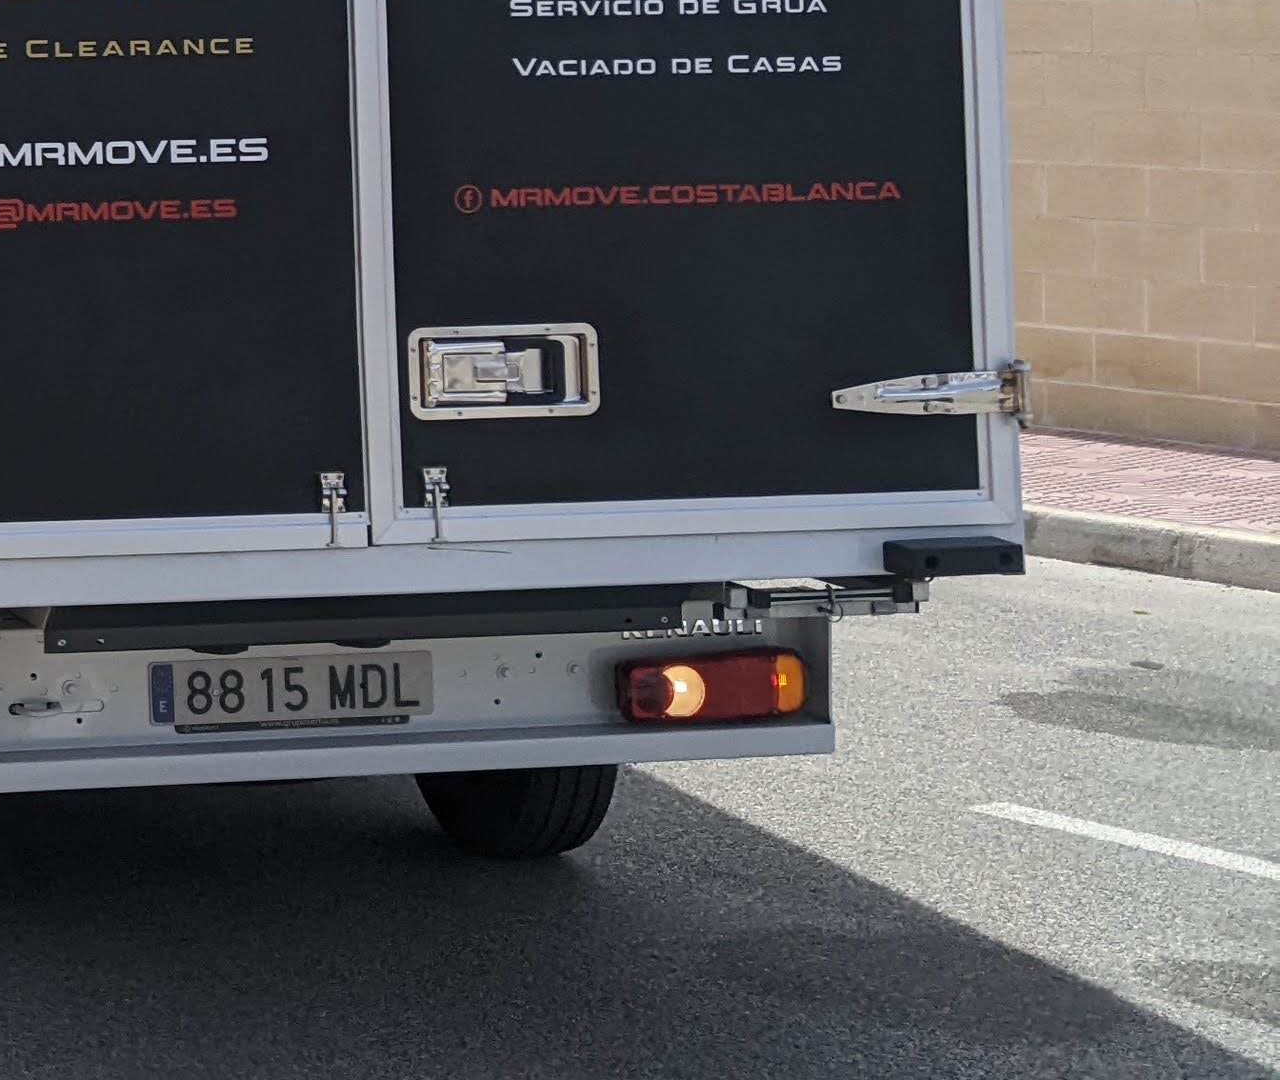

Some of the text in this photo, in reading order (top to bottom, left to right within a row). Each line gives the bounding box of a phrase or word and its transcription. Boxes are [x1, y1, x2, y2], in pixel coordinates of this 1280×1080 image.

[25, 37, 254, 58] CLEARANCE
[512, 54, 842, 76] VACIADO DE CASAS
[490, 181, 901, 208] MRMOVE.COSTABLANCA
[187, 667, 309, 715] 8815
[329, 662, 421, 711] MDL
